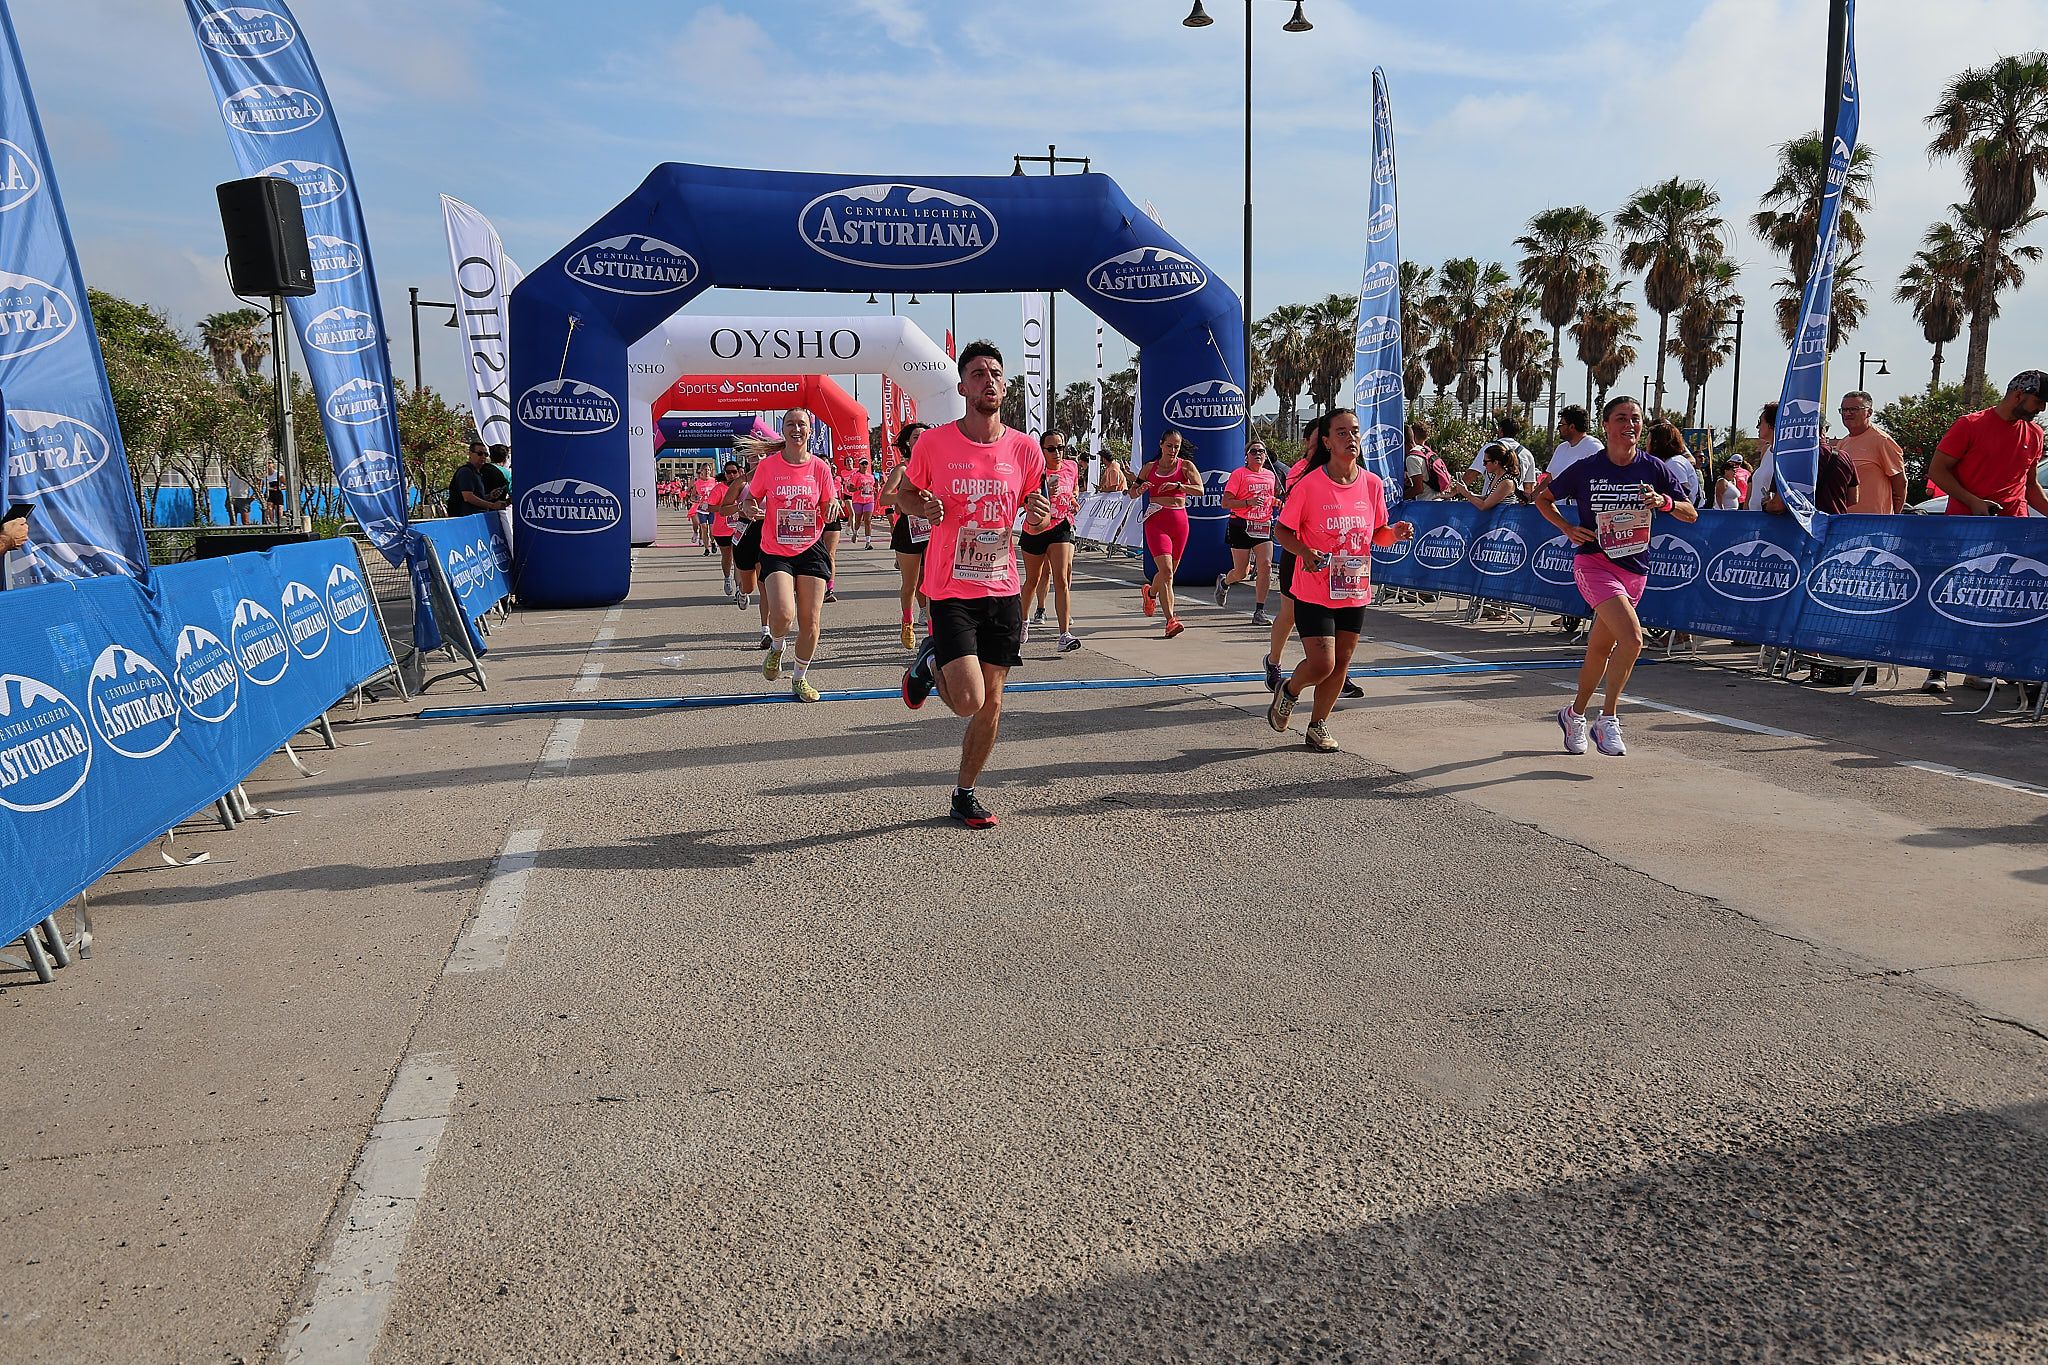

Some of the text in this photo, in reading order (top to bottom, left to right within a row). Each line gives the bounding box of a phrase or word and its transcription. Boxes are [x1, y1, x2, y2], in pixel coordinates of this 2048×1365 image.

[845, 206, 977, 219] CENTRAL LECHERA
[814, 206, 983, 247] ASTURIANA
[573, 254, 688, 282] ASTURIANA
[596, 253, 687, 266] CENTRAL LECHERA
[1116, 265, 1156, 274] CENTRAL
[1097, 270, 1202, 290] ASTURIANA
[710, 328, 861, 359] OYSHO
[628, 363, 665, 374] YSHO
[903, 361, 946, 371] OYSHO
[678, 381, 799, 396] Sports Santander
[522, 399, 615, 423] ASTURIANA
[576, 398, 612, 407] LECHERA
[1169, 399, 1244, 419] ASTURIANA
[776, 485, 813, 496] CARRERA
[952, 478, 1008, 496] CARRERA
[524, 498, 617, 521] ASTURIANA
[983, 501, 1000, 522] DE
[1326, 516, 1367, 530] CARRERA
[1615, 529, 1634, 540] 016
[975, 552, 997, 562] 016
[1417, 538, 1460, 559] ASTURIANA
[1472, 543, 1521, 566] ASTURIANA
[1728, 559, 1793, 570] CENTRAL LECHERA
[1345, 575, 1361, 584] 016
[1711, 560, 1790, 589] ASTURIANA
[1812, 568, 1908, 600] ASTURIANA
[240, 633, 286, 672] ASTURIANA
[0, 706, 70, 742] ENTRAL LECHERA
